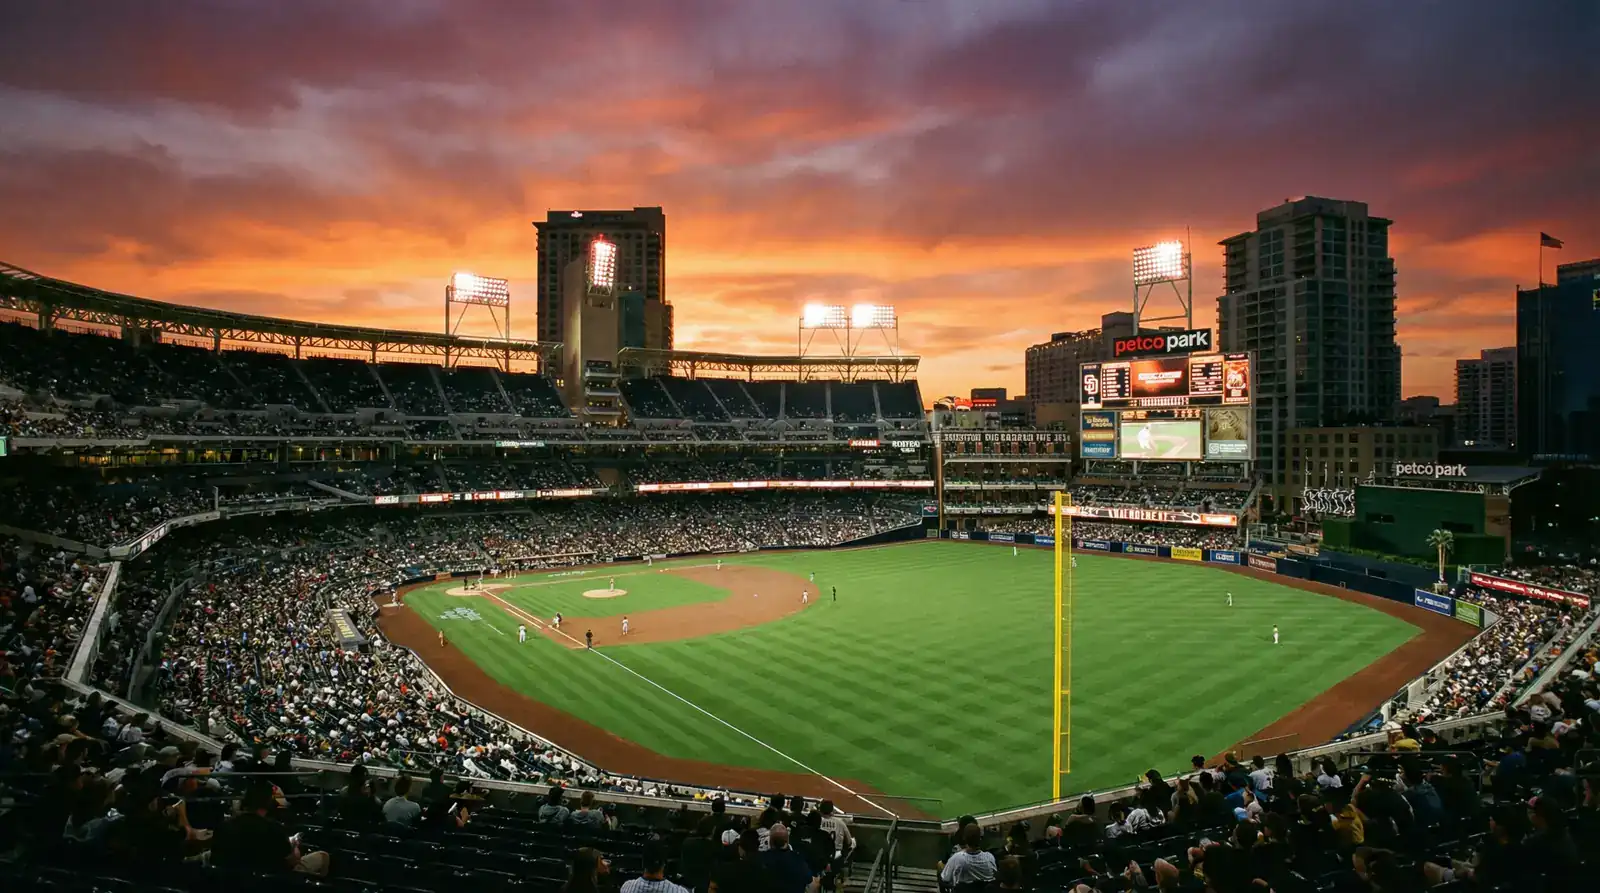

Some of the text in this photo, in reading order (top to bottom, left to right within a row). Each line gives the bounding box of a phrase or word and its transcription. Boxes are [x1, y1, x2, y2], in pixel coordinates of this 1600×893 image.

[1115, 331, 1208, 356] petco park
[1395, 462, 1467, 479] petco park
